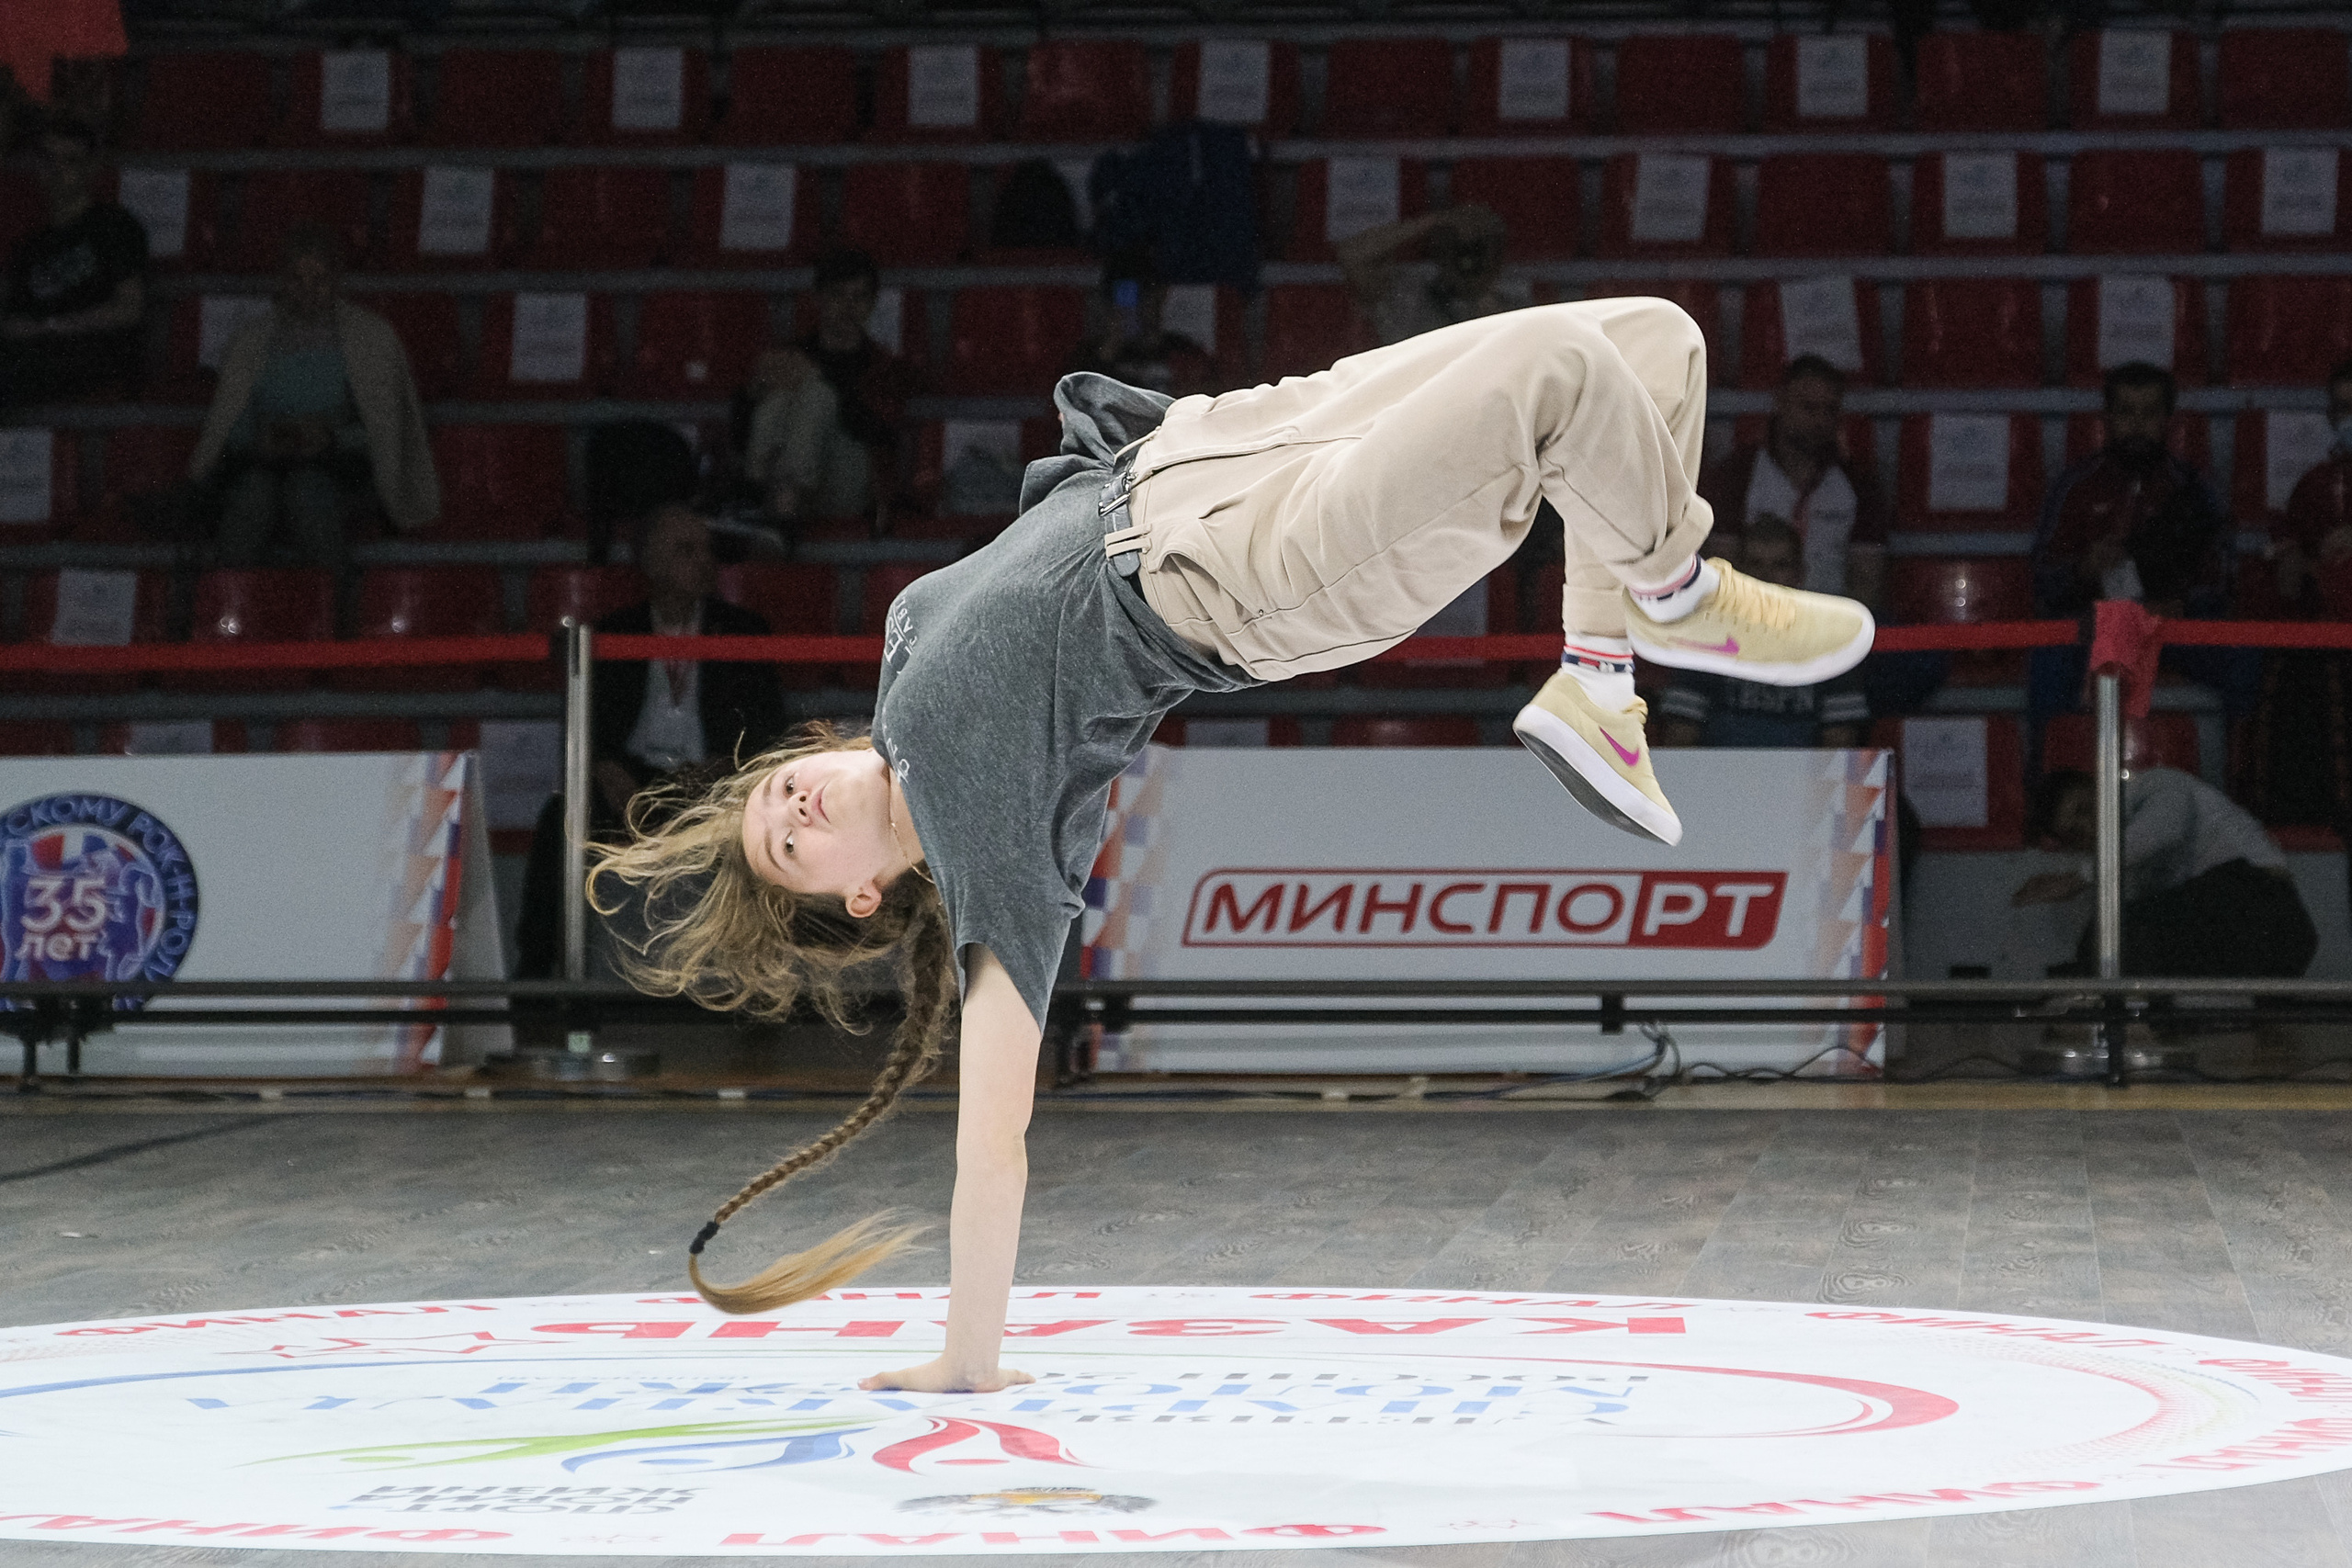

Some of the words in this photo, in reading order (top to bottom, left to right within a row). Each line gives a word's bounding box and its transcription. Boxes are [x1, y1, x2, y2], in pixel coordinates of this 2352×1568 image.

[2, 795, 130, 835] СКОМУ
[21, 877, 107, 933] 35
[1203, 883, 1774, 936] МИНСПОРТ
[1250, 1292, 1700, 1310] ФИНАЛ
[53, 1304, 499, 1336] ФИНАЛ
[530, 1316, 1687, 1339] КАЗАНЬ
[1804, 1311, 2171, 1348] ФИНАЛ
[182, 1396, 1630, 1416] СПАРТАКИАДА
[348, 1495, 695, 1505] НОРМА
[368, 1485, 712, 1495] ЖИЗНИ
[384, 1504, 678, 1515] СПОРТ
[1586, 1481, 2102, 1524] ФИНАЛ
[718, 1523, 1387, 1546] ФИНАЛ
